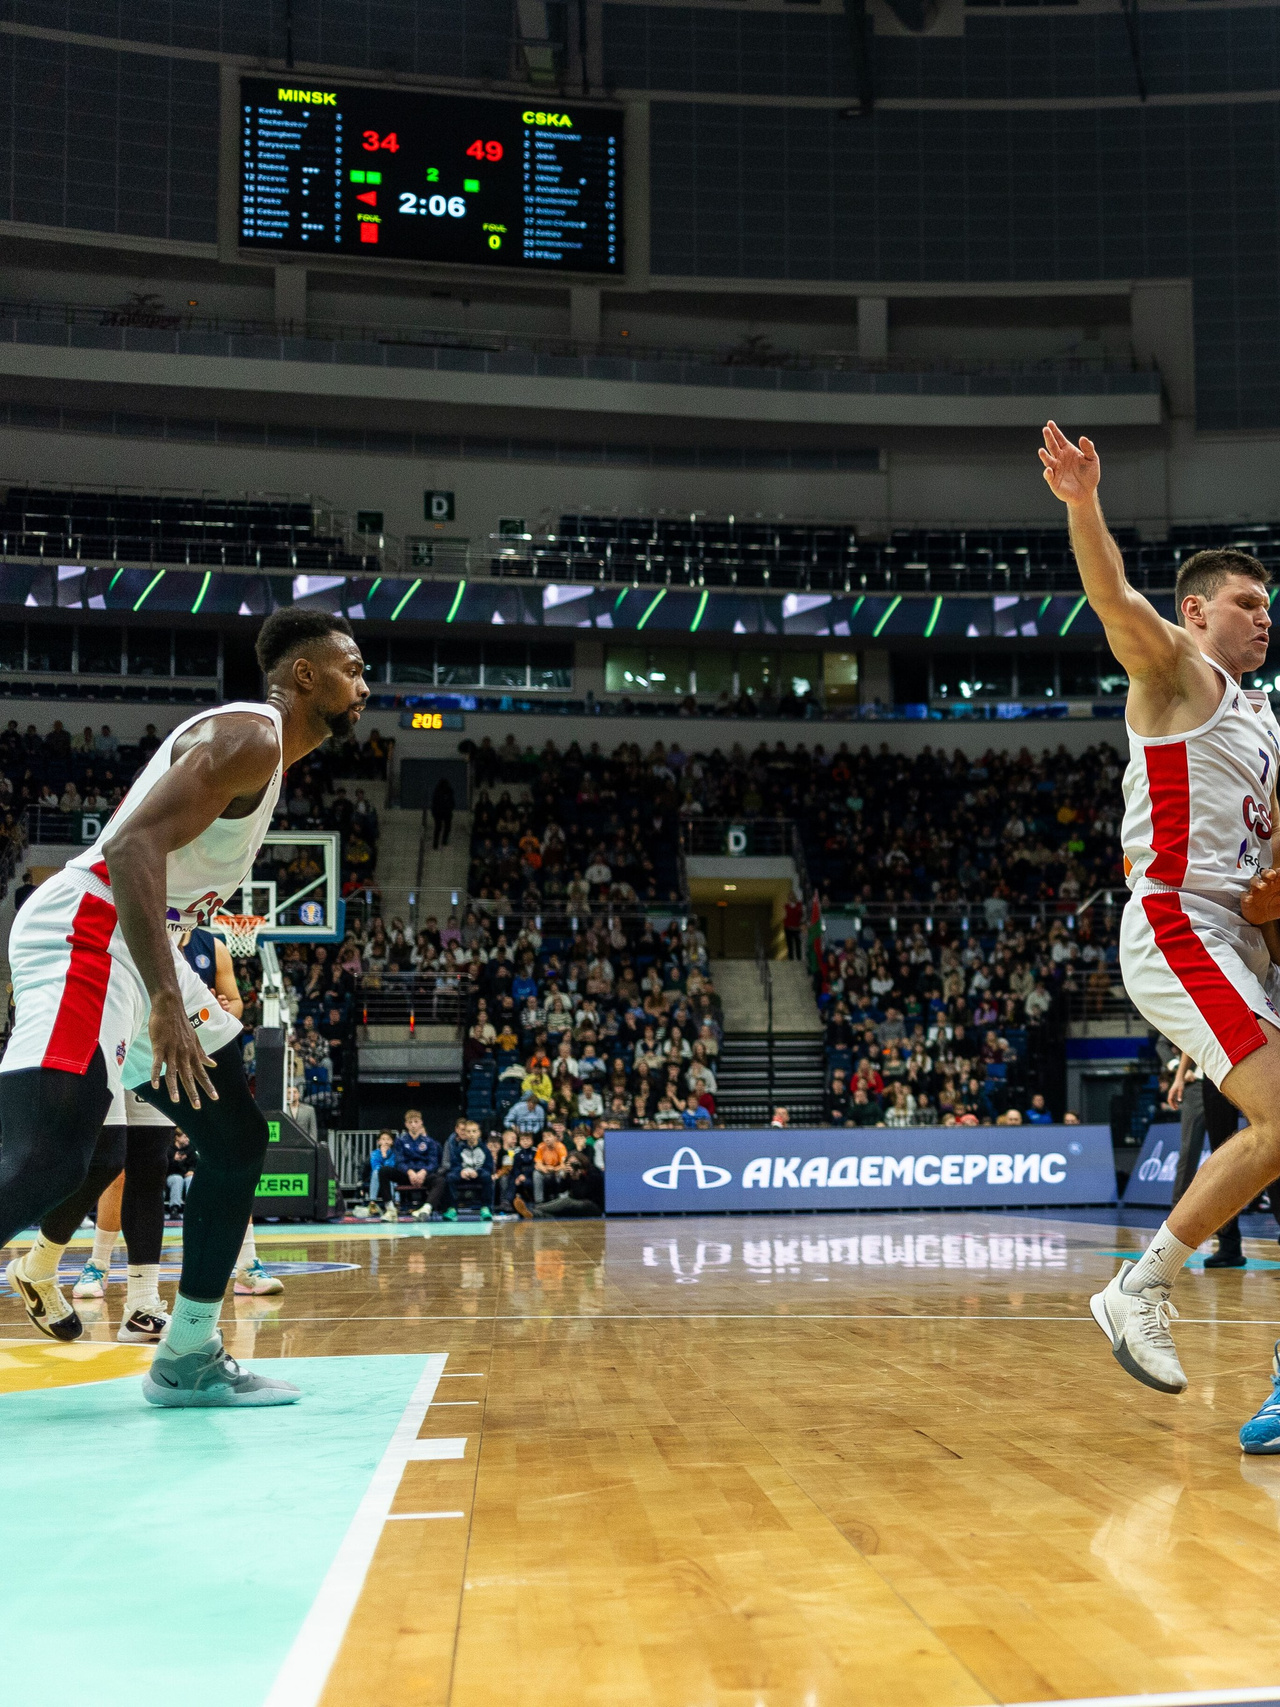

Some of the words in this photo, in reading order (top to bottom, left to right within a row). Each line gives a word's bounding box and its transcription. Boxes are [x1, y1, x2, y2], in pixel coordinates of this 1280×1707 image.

[278, 88, 337, 106] MINSK
[522, 111, 573, 128] CSKA
[362, 130, 399, 153] 34
[466, 139, 503, 162] 49
[426, 167, 439, 182] 2
[399, 192, 466, 217] 2:06
[488, 234, 501, 249] 0
[432, 496, 449, 516] D
[1258, 748, 1270, 786] 7
[82, 818, 101, 840] D
[728, 831, 747, 851] D
[741, 1152, 1068, 1189] АКАДЕМСЕРВИС
